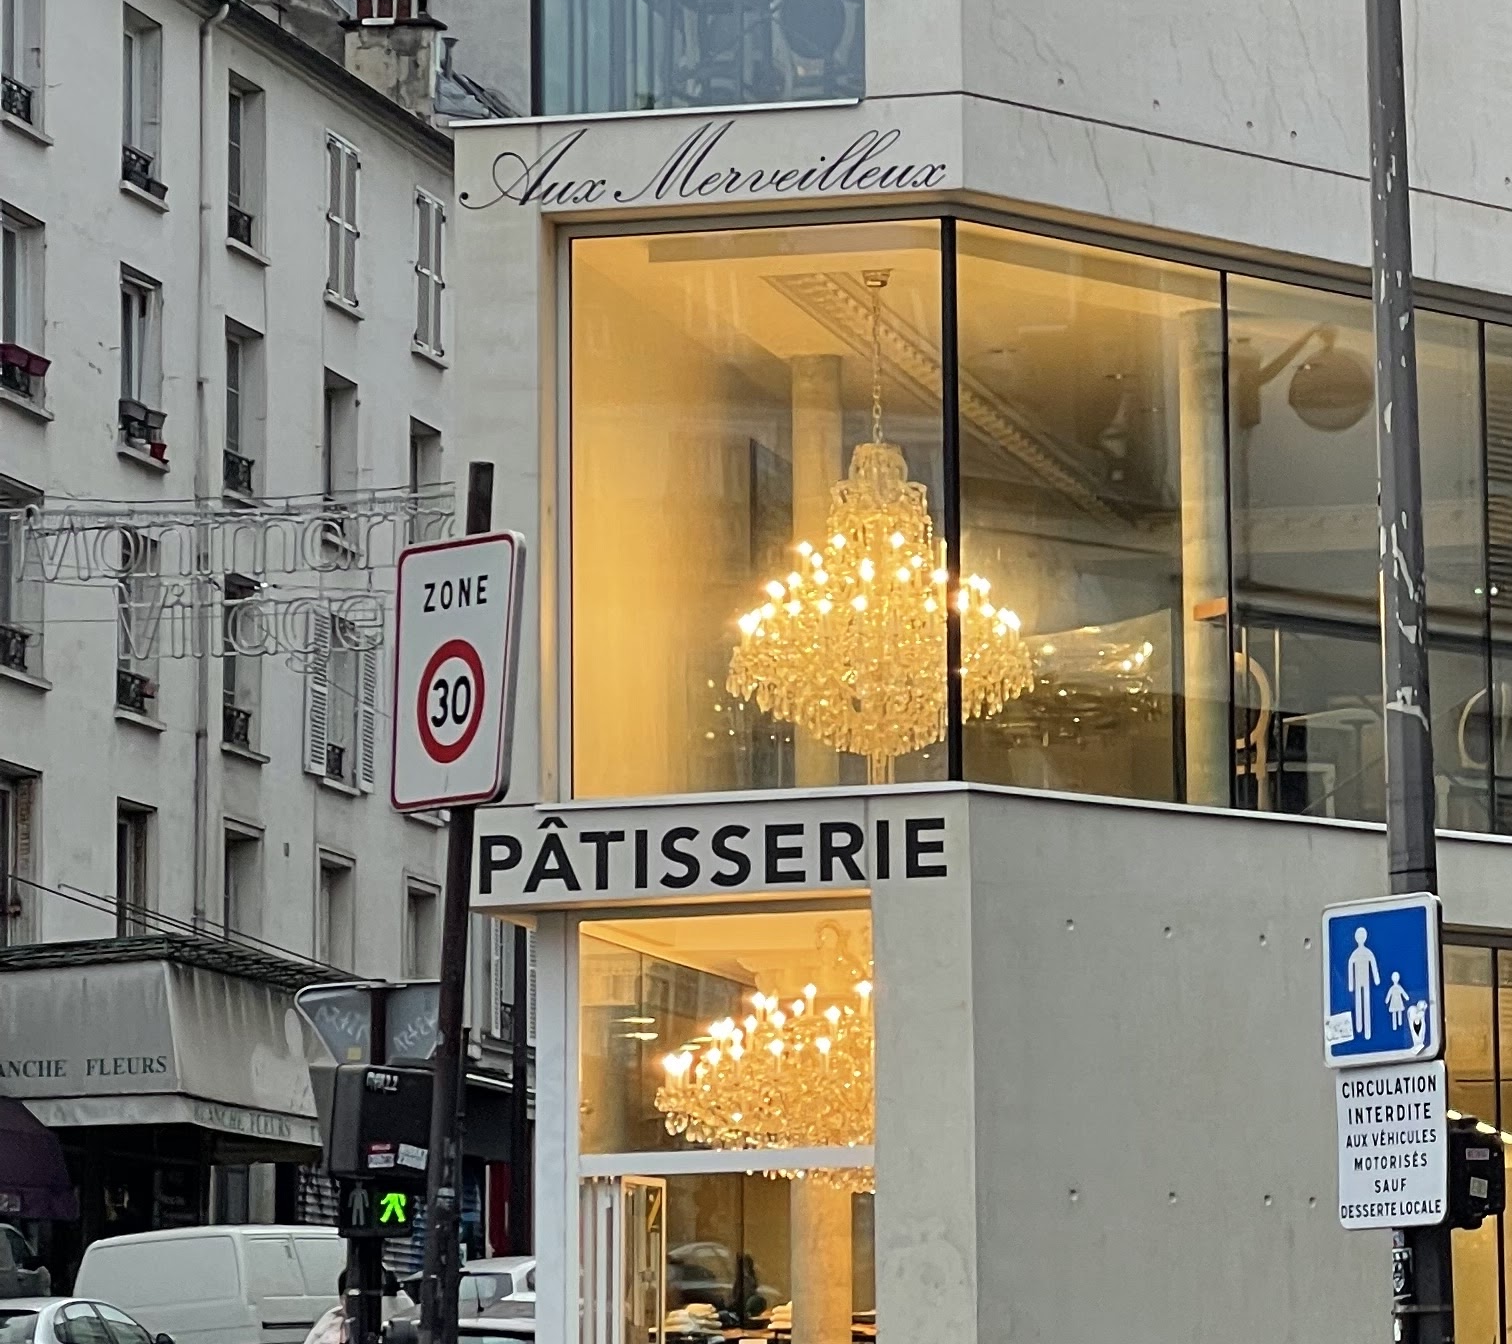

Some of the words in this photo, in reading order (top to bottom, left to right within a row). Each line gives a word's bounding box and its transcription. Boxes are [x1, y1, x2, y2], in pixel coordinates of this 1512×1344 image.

[458, 128, 607, 210] Aux
[614, 120, 947, 202] Merveilleux
[423, 574, 489, 613] ZONE
[113, 581, 385, 675] Village
[430, 676, 471, 728] 30
[478, 816, 947, 895] PÂTISSERIE
[86, 1056, 167, 1077] FLEURS
[1342, 1075, 1436, 1099] CIRCULATION
[1348, 1103, 1432, 1124] INTERDITE
[1345, 1132, 1368, 1148] AUX
[1371, 1128, 1437, 1148] VÉHICULES
[1354, 1151, 1428, 1171] MOTORISÉS
[1374, 1177, 1407, 1194] SAUF
[1341, 1201, 1398, 1219] DESSERTE
[1400, 1198, 1441, 1216] LOCALE
